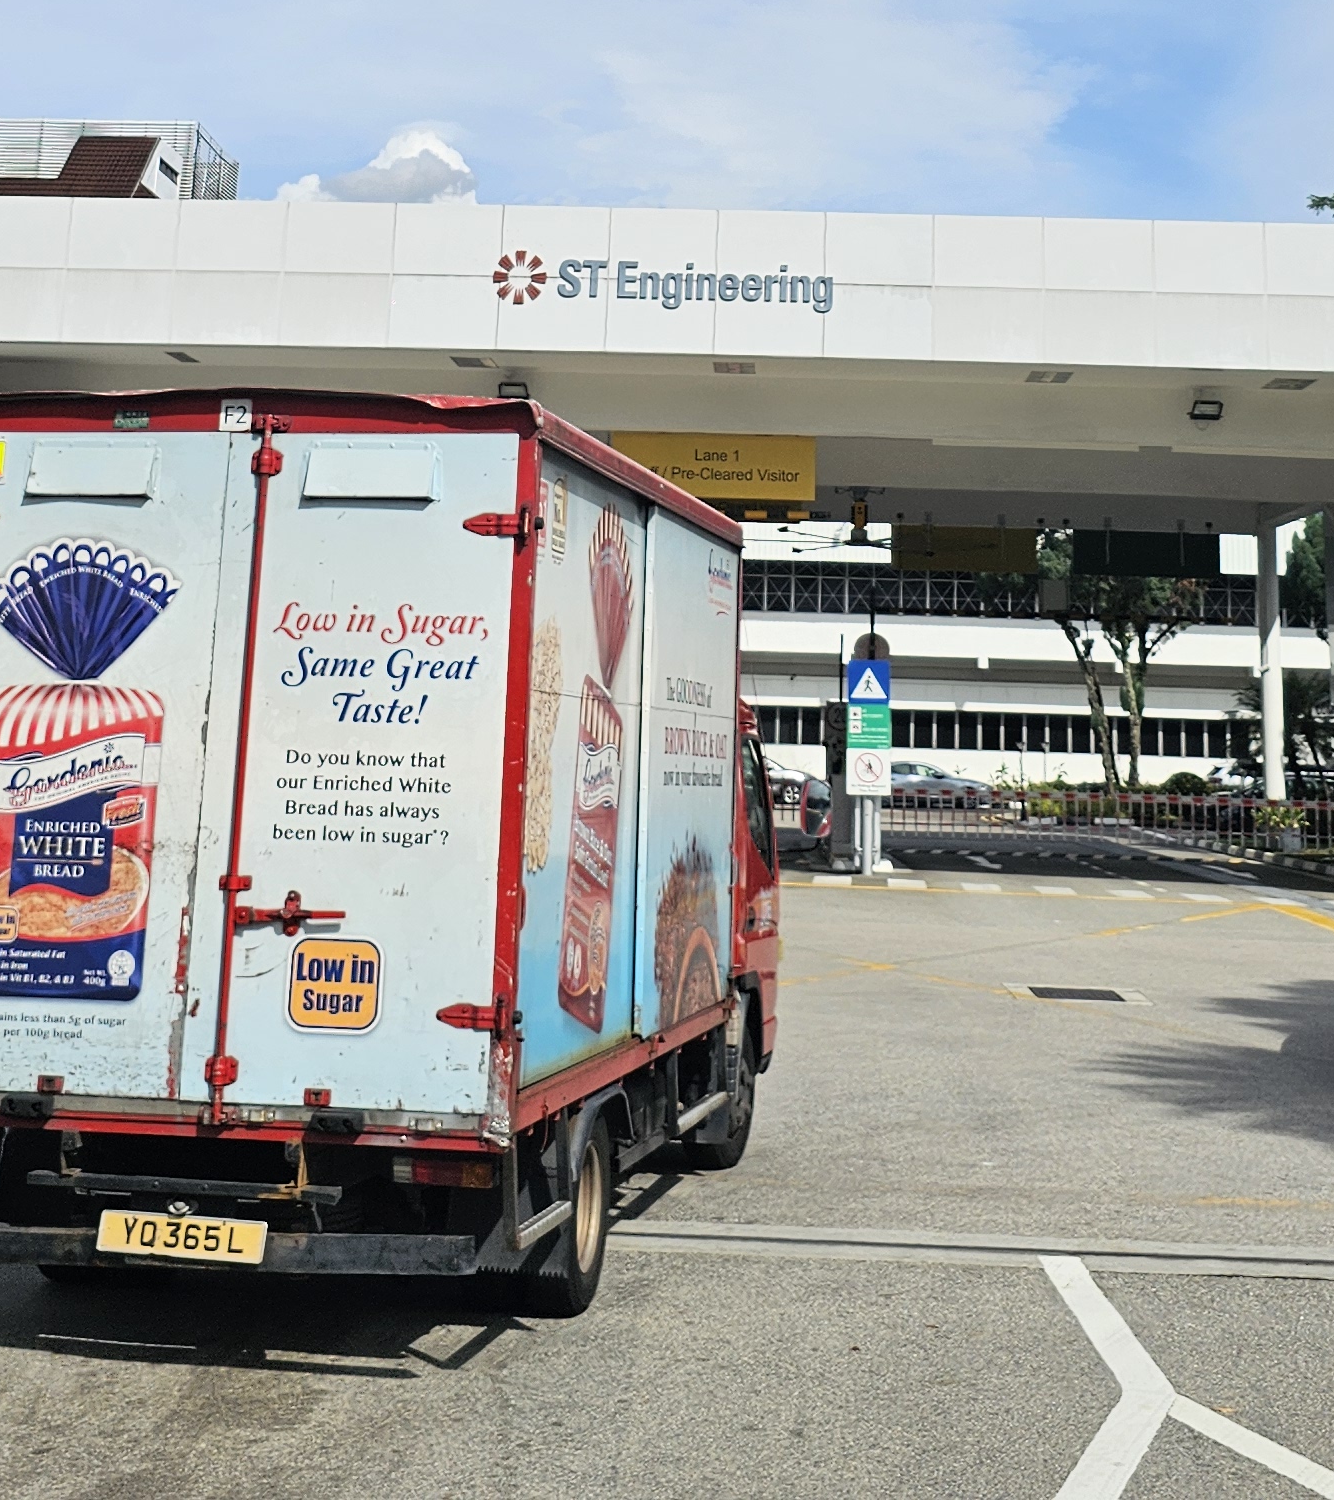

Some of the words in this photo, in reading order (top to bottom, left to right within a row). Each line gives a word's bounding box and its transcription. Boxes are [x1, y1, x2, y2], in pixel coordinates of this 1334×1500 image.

[557, 258, 609, 299] ST
[616, 260, 835, 314] Engineering
[224, 405, 247, 424] F2
[694, 448, 728, 462] Lane
[732, 449, 740, 463] 1
[671, 466, 754, 482] Pre-Cleared
[757, 468, 800, 483] Visitor
[273, 601, 338, 640] Low
[346, 604, 376, 633] in
[380, 603, 490, 647] Sugar,
[280, 646, 376, 687] Same
[386, 648, 480, 692] Great
[332, 688, 429, 725] Taste!
[285, 749, 311, 765] Do
[317, 753, 350, 768] you
[356, 750, 404, 767] know
[410, 752, 446, 769] that
[3, 753, 127, 807] Gardenia
[276, 776, 307, 790] our
[313, 774, 393, 792] Enriched
[398, 776, 452, 794] White
[285, 799, 338, 816] Bread
[344, 800, 374, 817] has
[379, 802, 440, 822] always
[25, 818, 101, 834] ENRICHED
[272, 823, 316, 841] been
[323, 825, 355, 842] low
[360, 826, 376, 843] in
[18, 834, 106, 858] WHITE
[34, 863, 85, 878] BREAD
[296, 952, 345, 983] Low
[350, 954, 375, 984] in
[302, 988, 365, 1015] Sugar
[20, 1012, 40, 1023] less
[43, 1013, 66, 1024] than
[67, 1015, 82, 1026] 5g
[84, 1014, 96, 1025] of
[97, 1017, 127, 1028] sugar
[3, 1028, 21, 1038] per
[25, 1027, 50, 1040] 100g
[52, 1028, 83, 1040] bread
